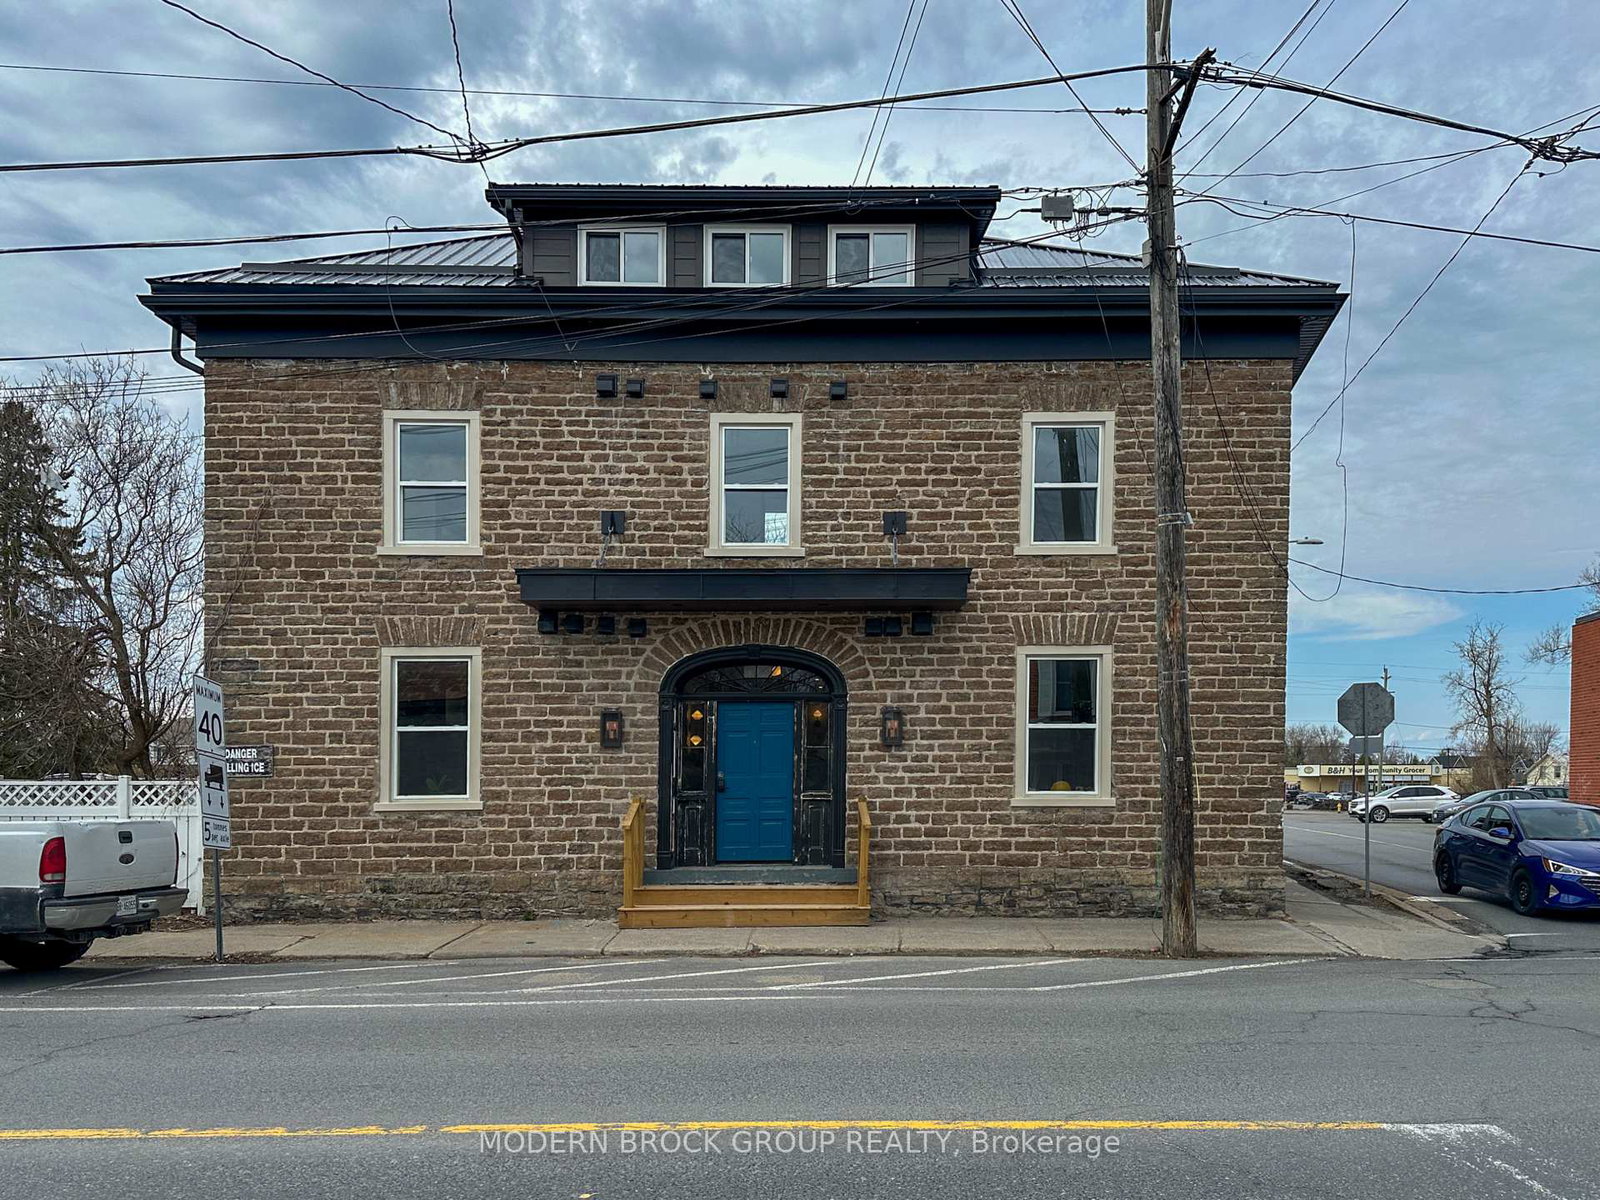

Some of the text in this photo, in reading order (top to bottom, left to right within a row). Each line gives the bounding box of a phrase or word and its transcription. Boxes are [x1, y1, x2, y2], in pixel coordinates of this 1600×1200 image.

[196, 684, 221, 703] MAXIMUM
[198, 710, 222, 746] 40
[225, 748, 257, 758] DANGER
[226, 762, 265, 773] LLING ICE
[204, 821, 211, 842] 5
